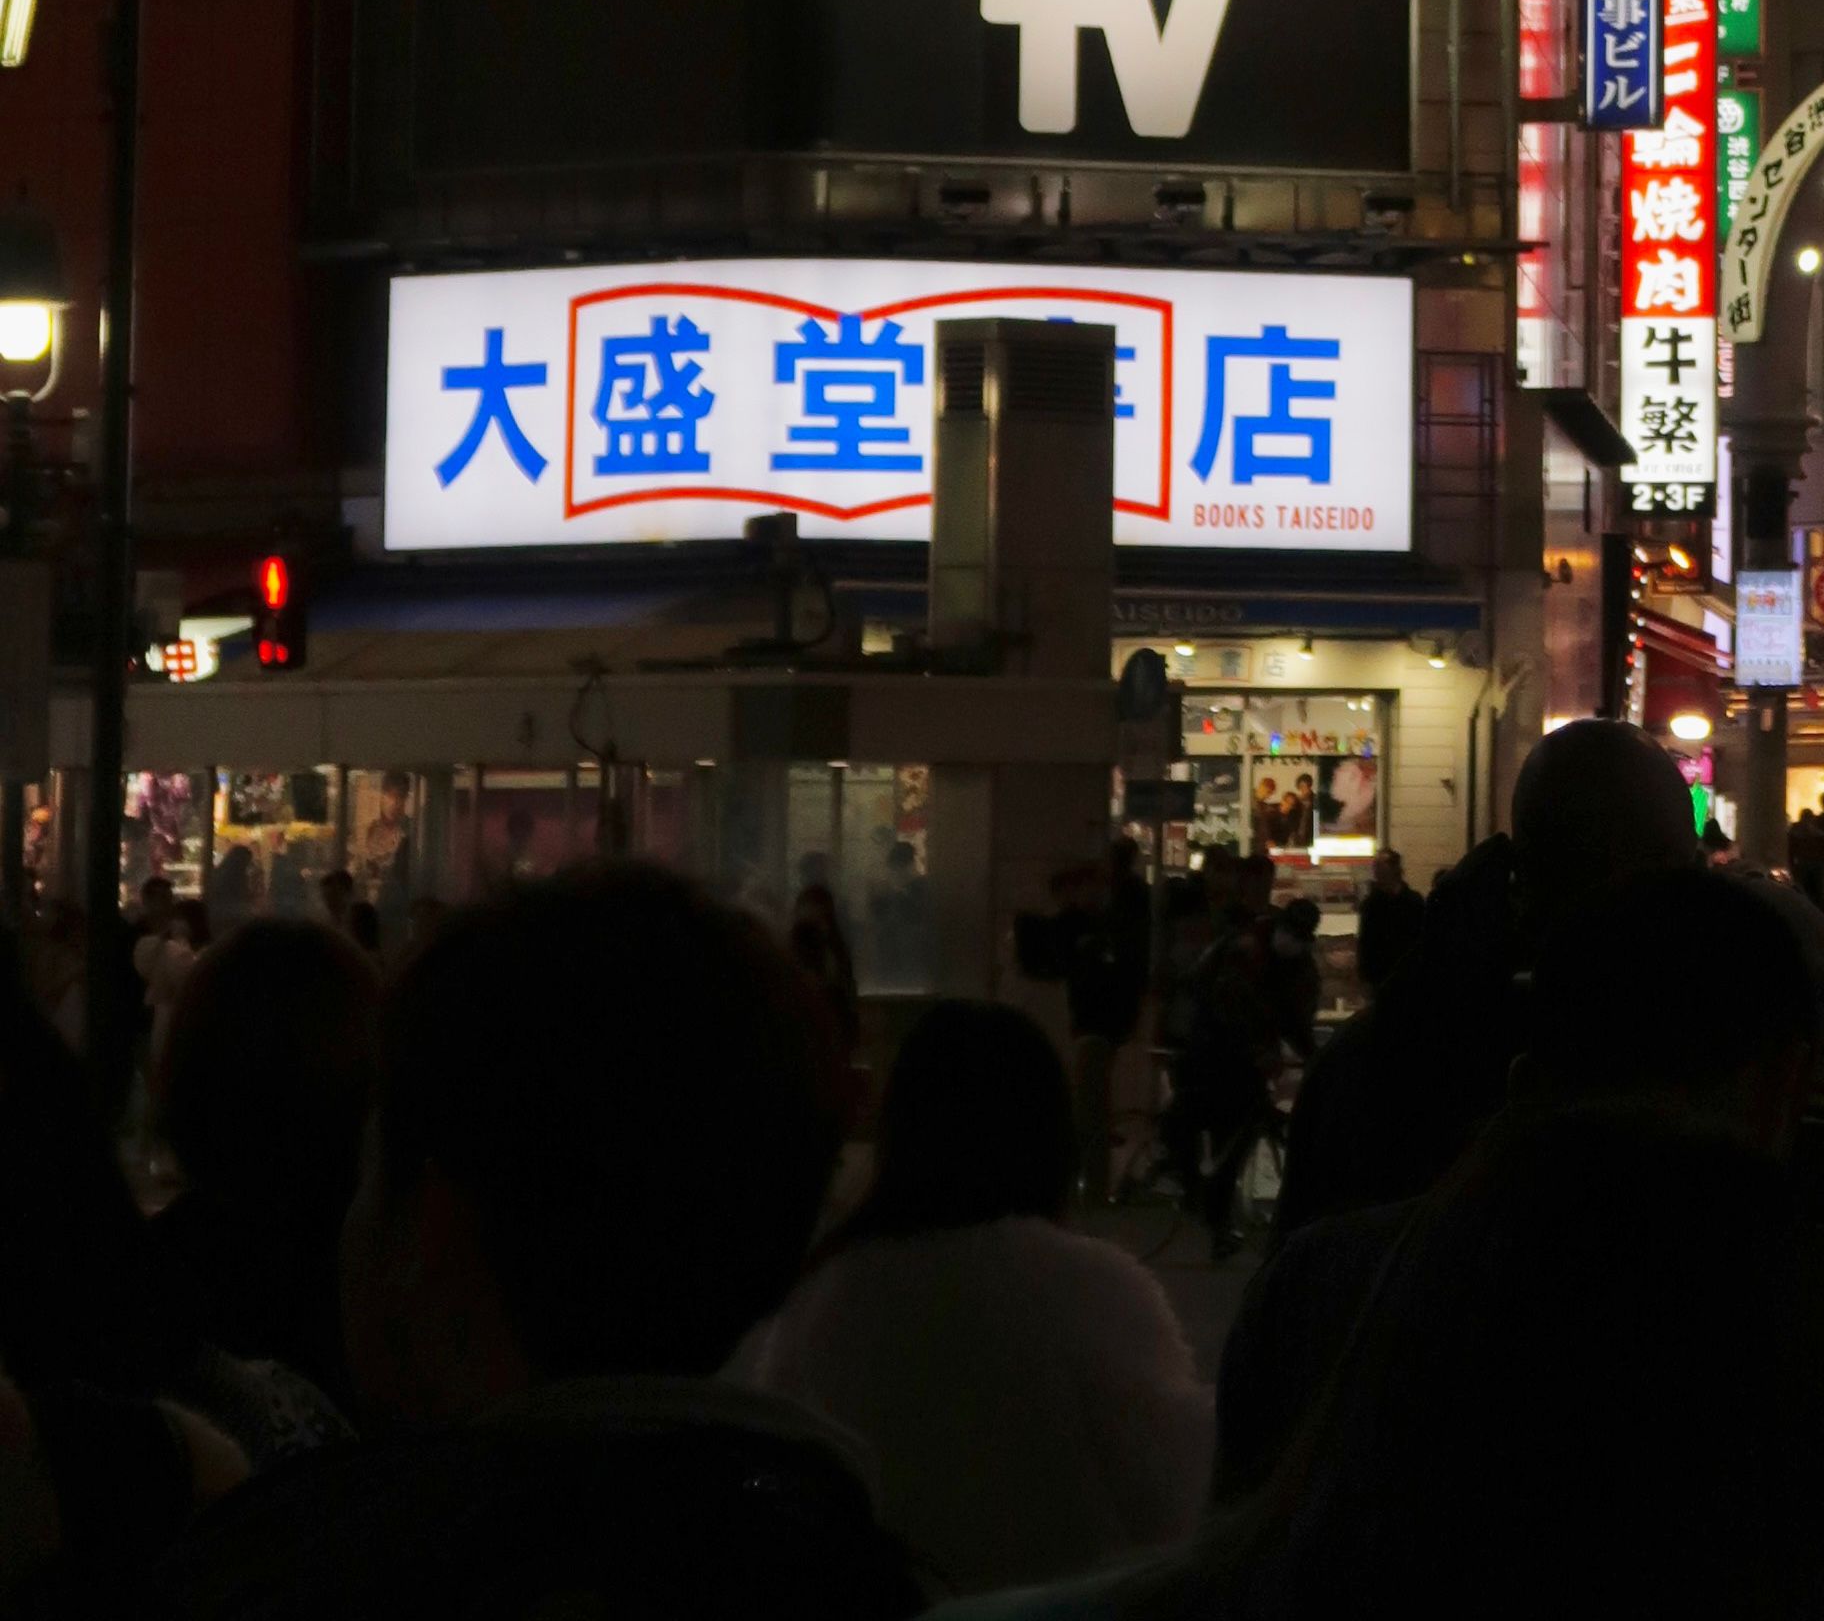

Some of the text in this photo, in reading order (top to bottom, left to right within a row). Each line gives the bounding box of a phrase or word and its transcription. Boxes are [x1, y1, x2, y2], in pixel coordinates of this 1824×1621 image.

[434, 313, 1341, 489] 大盛堂店
[1640, 326, 1699, 454] 牛繁
[1194, 503, 1376, 532] BOOKS TAISEIDO
